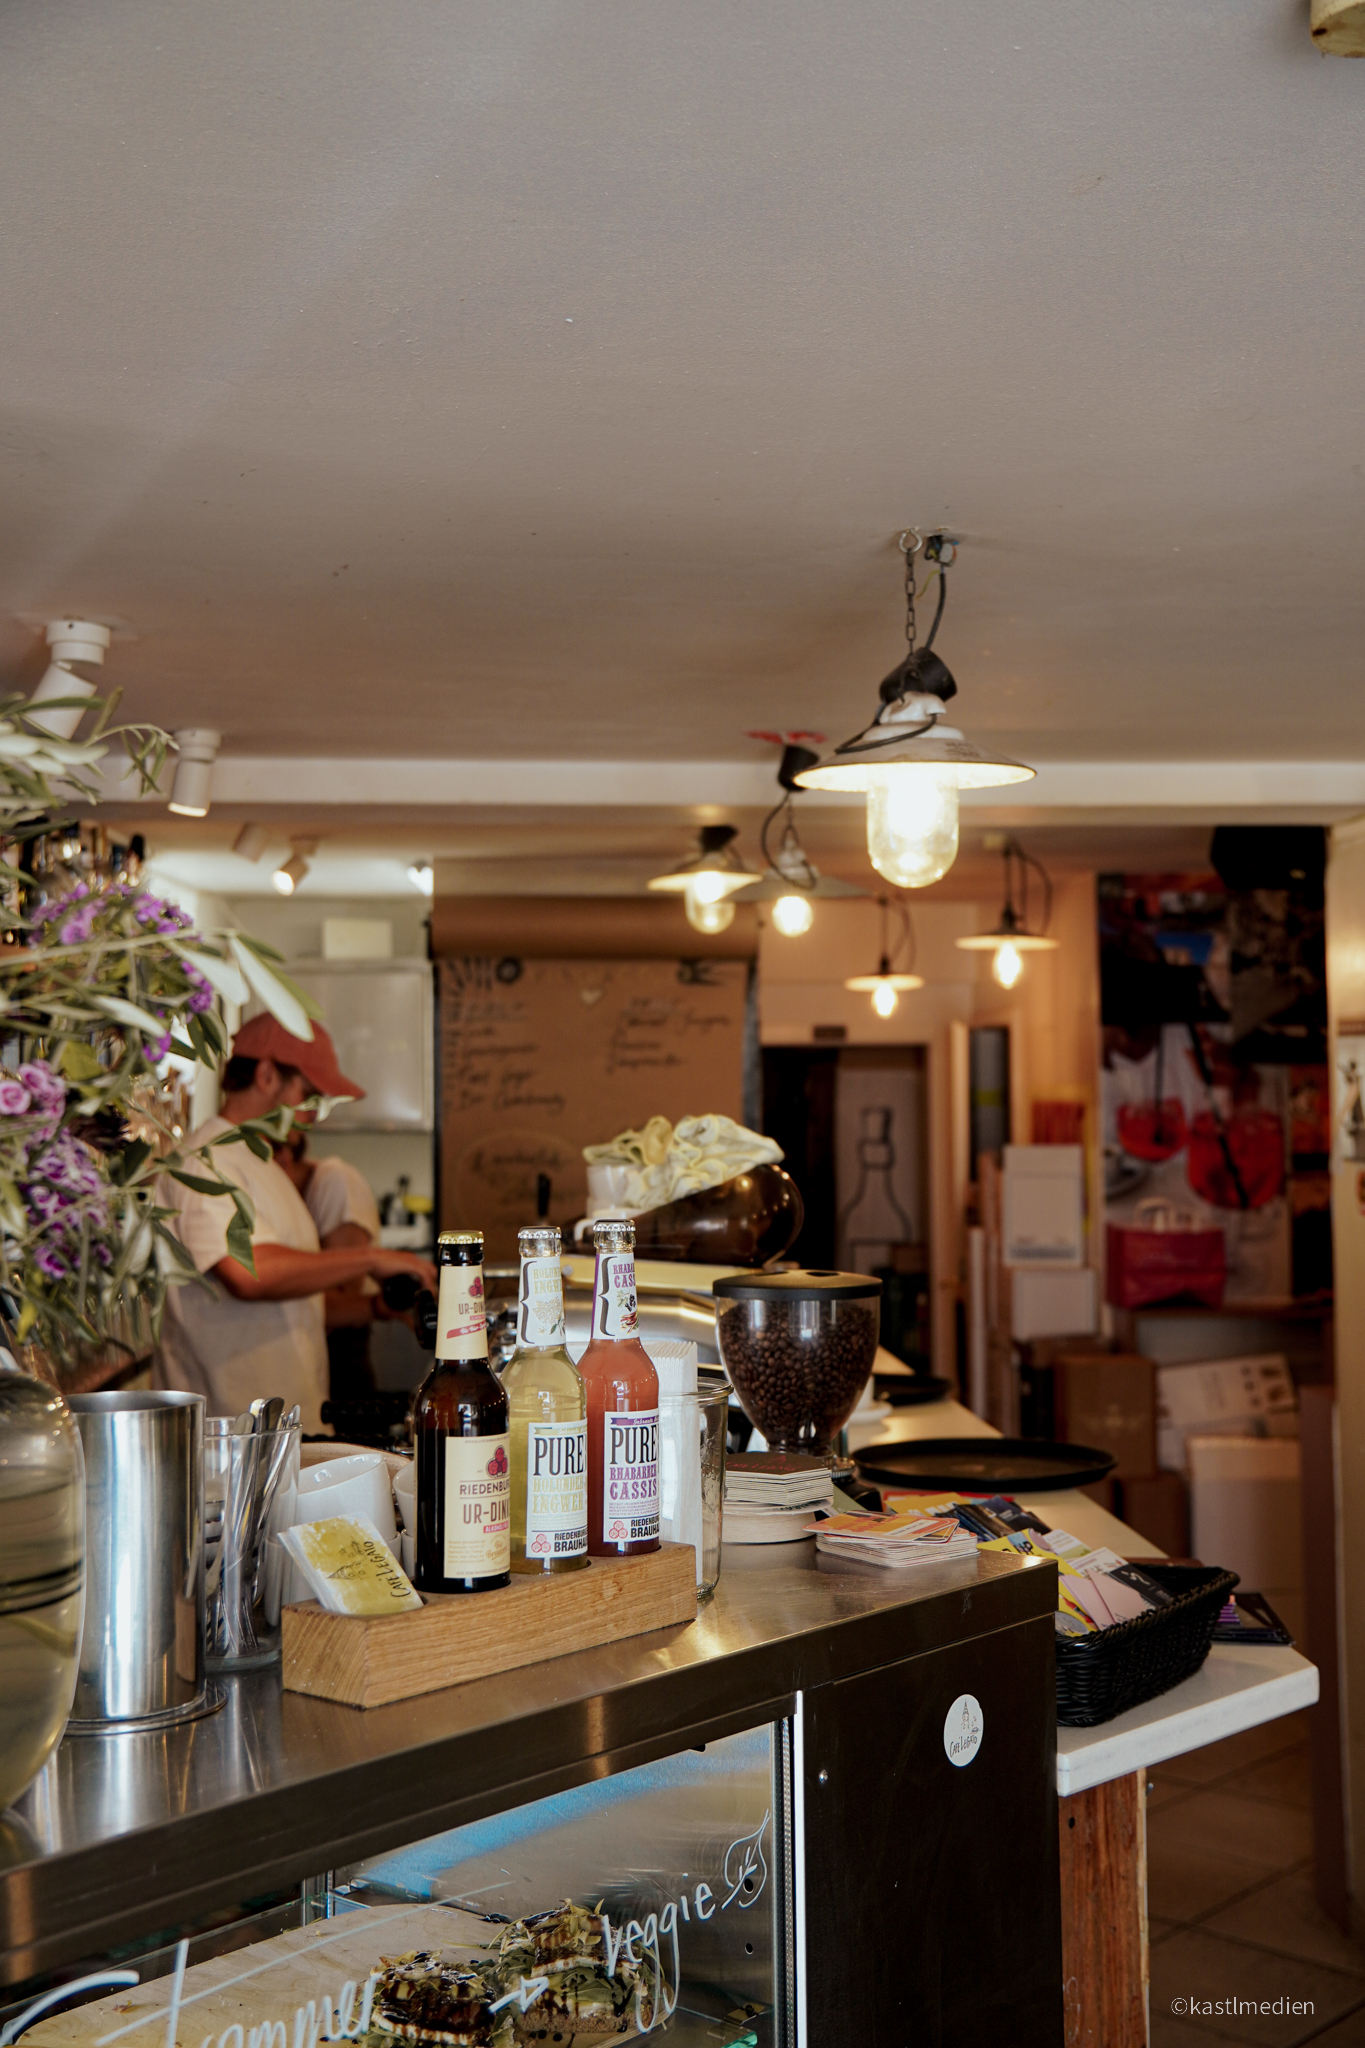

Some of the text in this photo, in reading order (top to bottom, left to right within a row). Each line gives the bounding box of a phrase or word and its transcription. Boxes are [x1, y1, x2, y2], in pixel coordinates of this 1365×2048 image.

[609, 1464, 657, 1480] RHABARBER
[532, 1476, 584, 1493] HOLUNDER
[609, 1478, 657, 1501] CASSIS
[532, 1491, 584, 1514] INGWER
[363, 1541, 394, 1578] LEGATO
